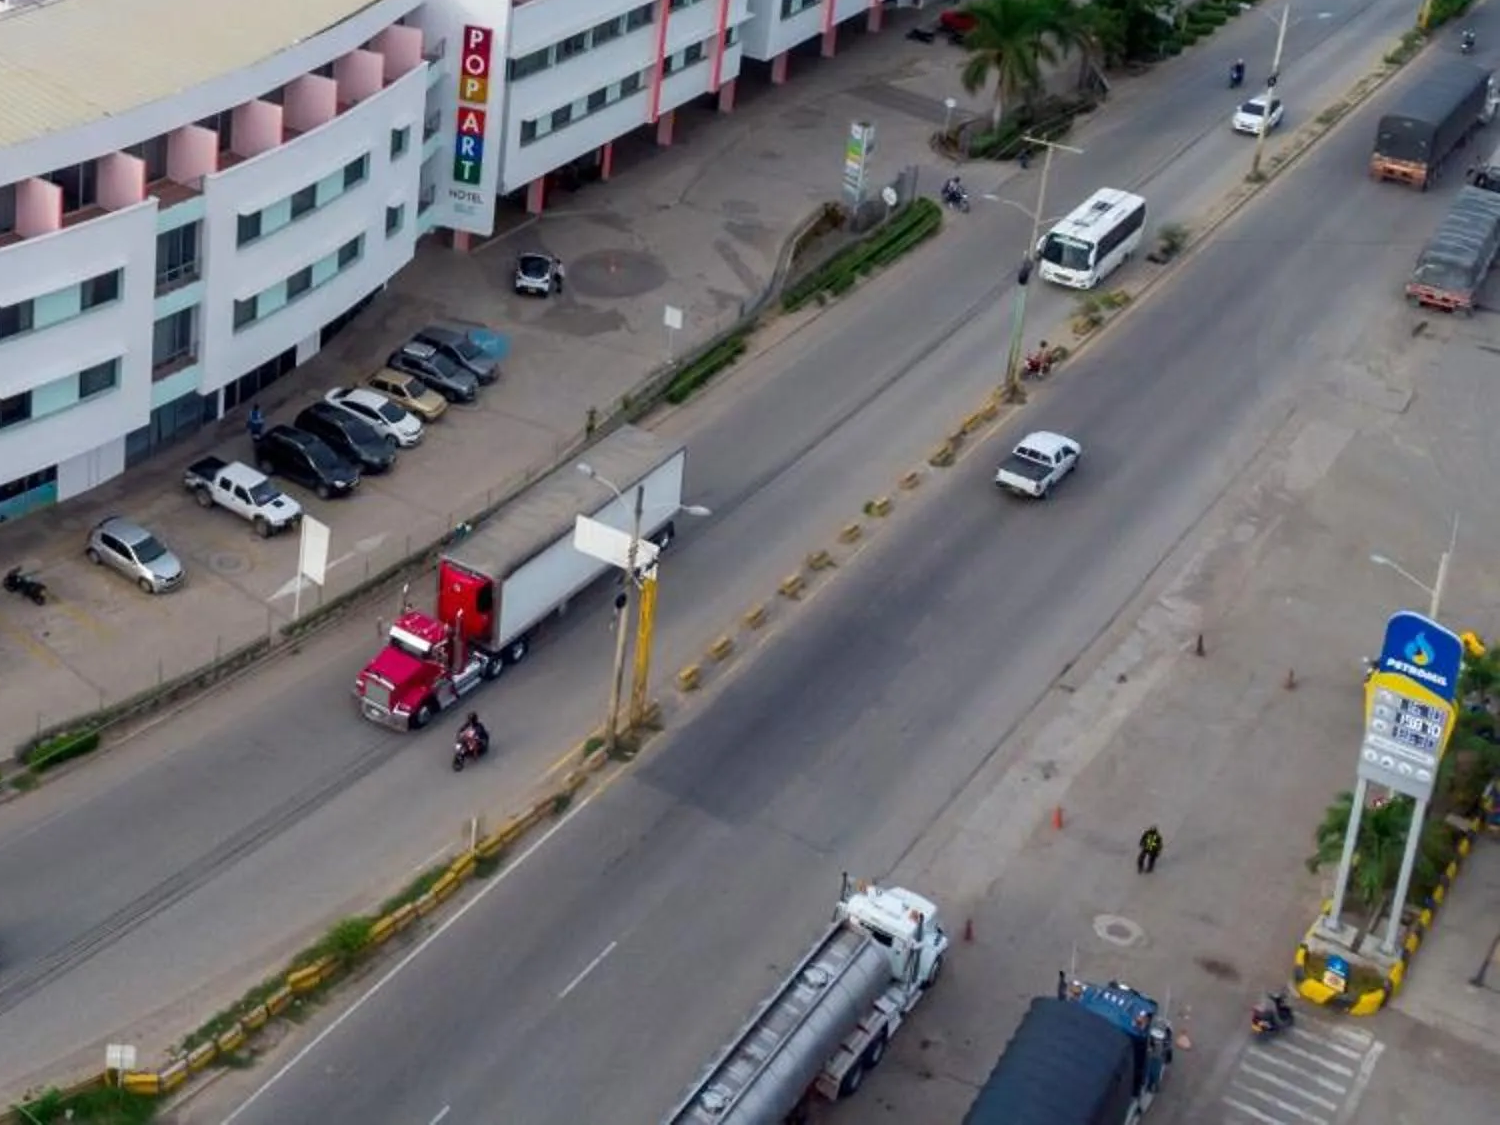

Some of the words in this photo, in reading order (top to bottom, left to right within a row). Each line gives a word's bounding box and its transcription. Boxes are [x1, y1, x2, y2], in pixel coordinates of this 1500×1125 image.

[465, 29, 485, 99] POP
[460, 112, 479, 180] ART
[449, 189, 484, 204] HOTEL
